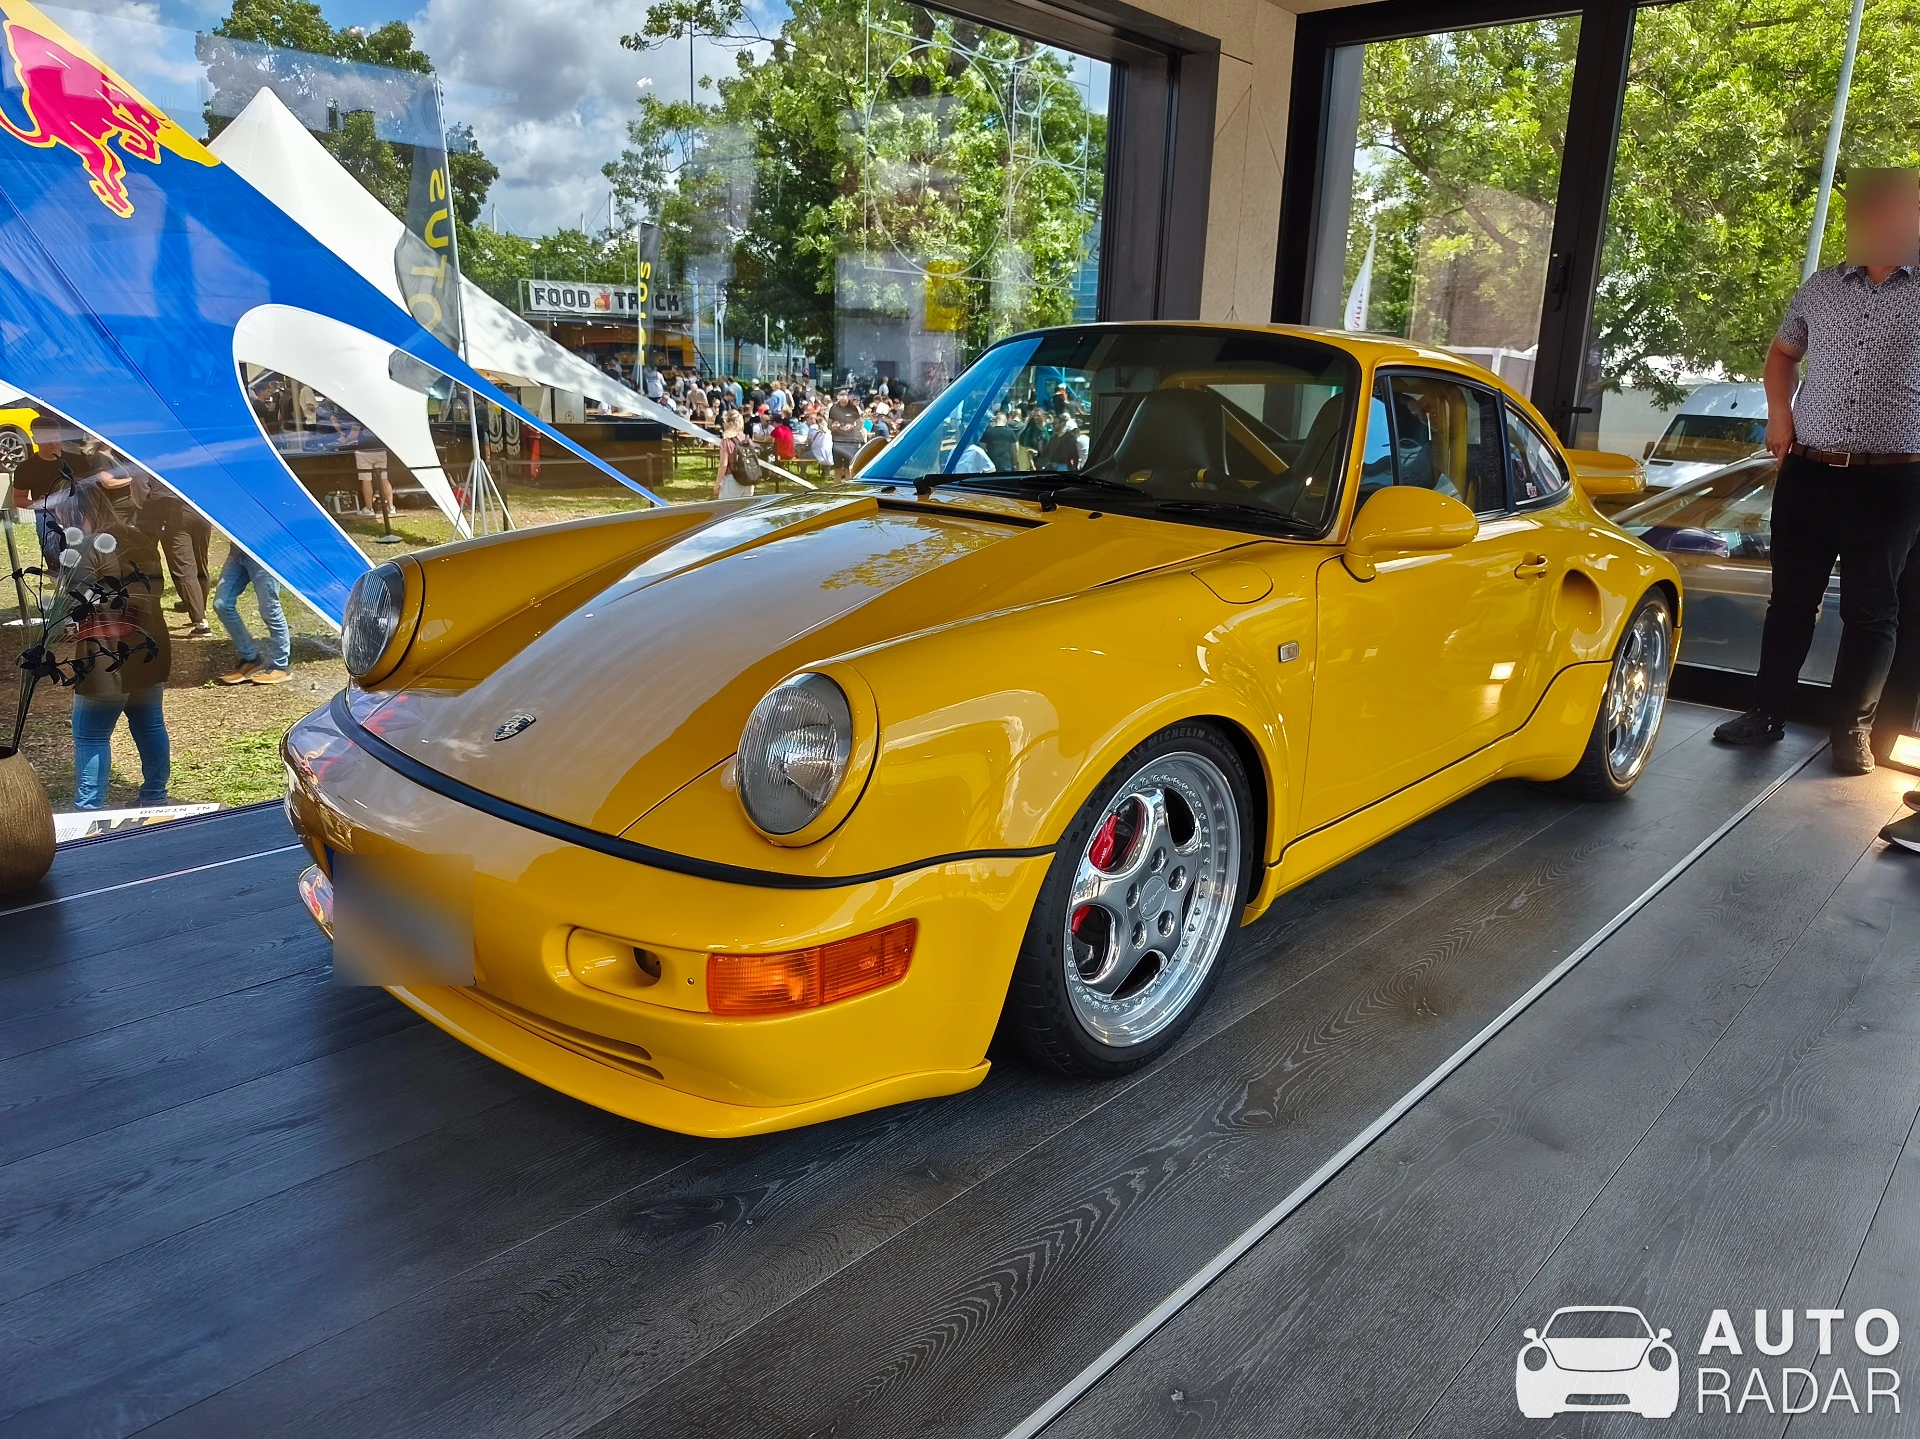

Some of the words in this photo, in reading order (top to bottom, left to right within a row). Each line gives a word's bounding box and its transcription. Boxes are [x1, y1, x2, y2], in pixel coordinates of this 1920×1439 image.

[534, 287, 591, 309] FOOD
[614, 292, 680, 312] TRCK
[1148, 727, 1206, 749] MICHELIN
[1208, 734, 1223, 747] PILOT
[1223, 746, 1237, 763] SPORT
[139, 807, 187, 815] BENZIN
